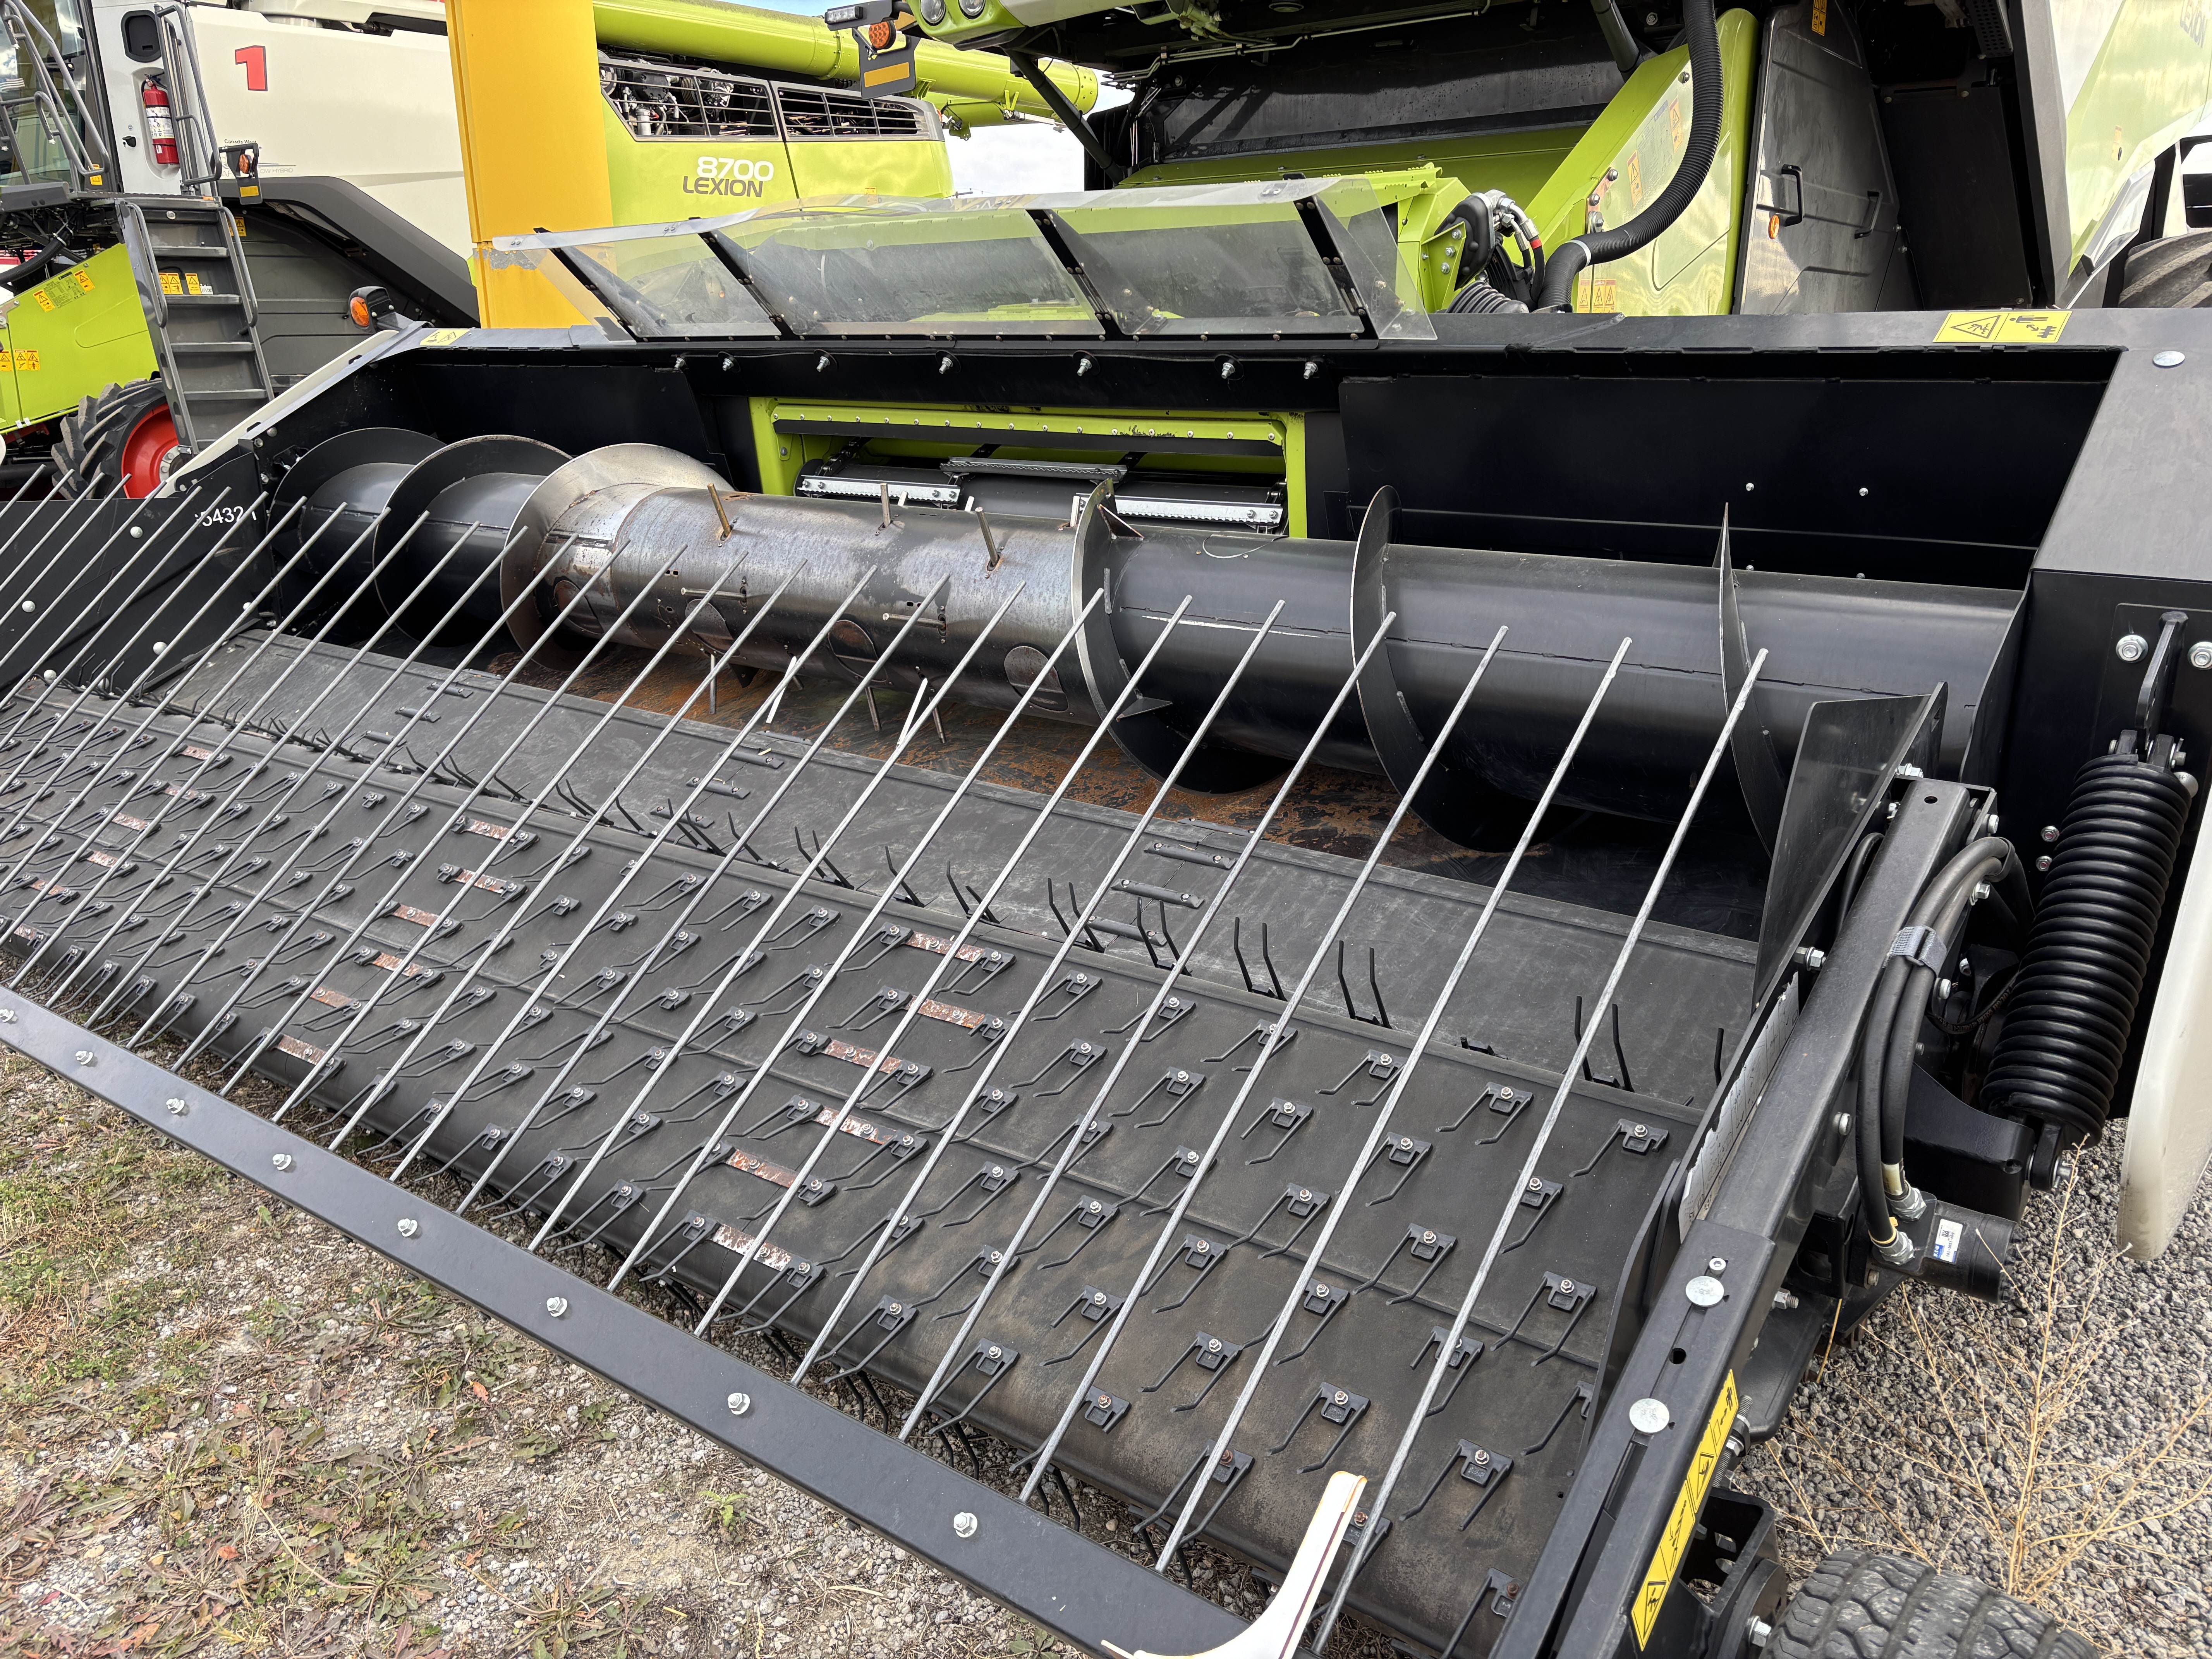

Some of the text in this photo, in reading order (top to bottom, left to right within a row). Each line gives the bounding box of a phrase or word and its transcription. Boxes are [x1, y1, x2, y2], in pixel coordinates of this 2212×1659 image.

[235, 45, 268, 91] 1
[697, 156, 774, 182] 8700
[683, 176, 763, 198] LEXION
